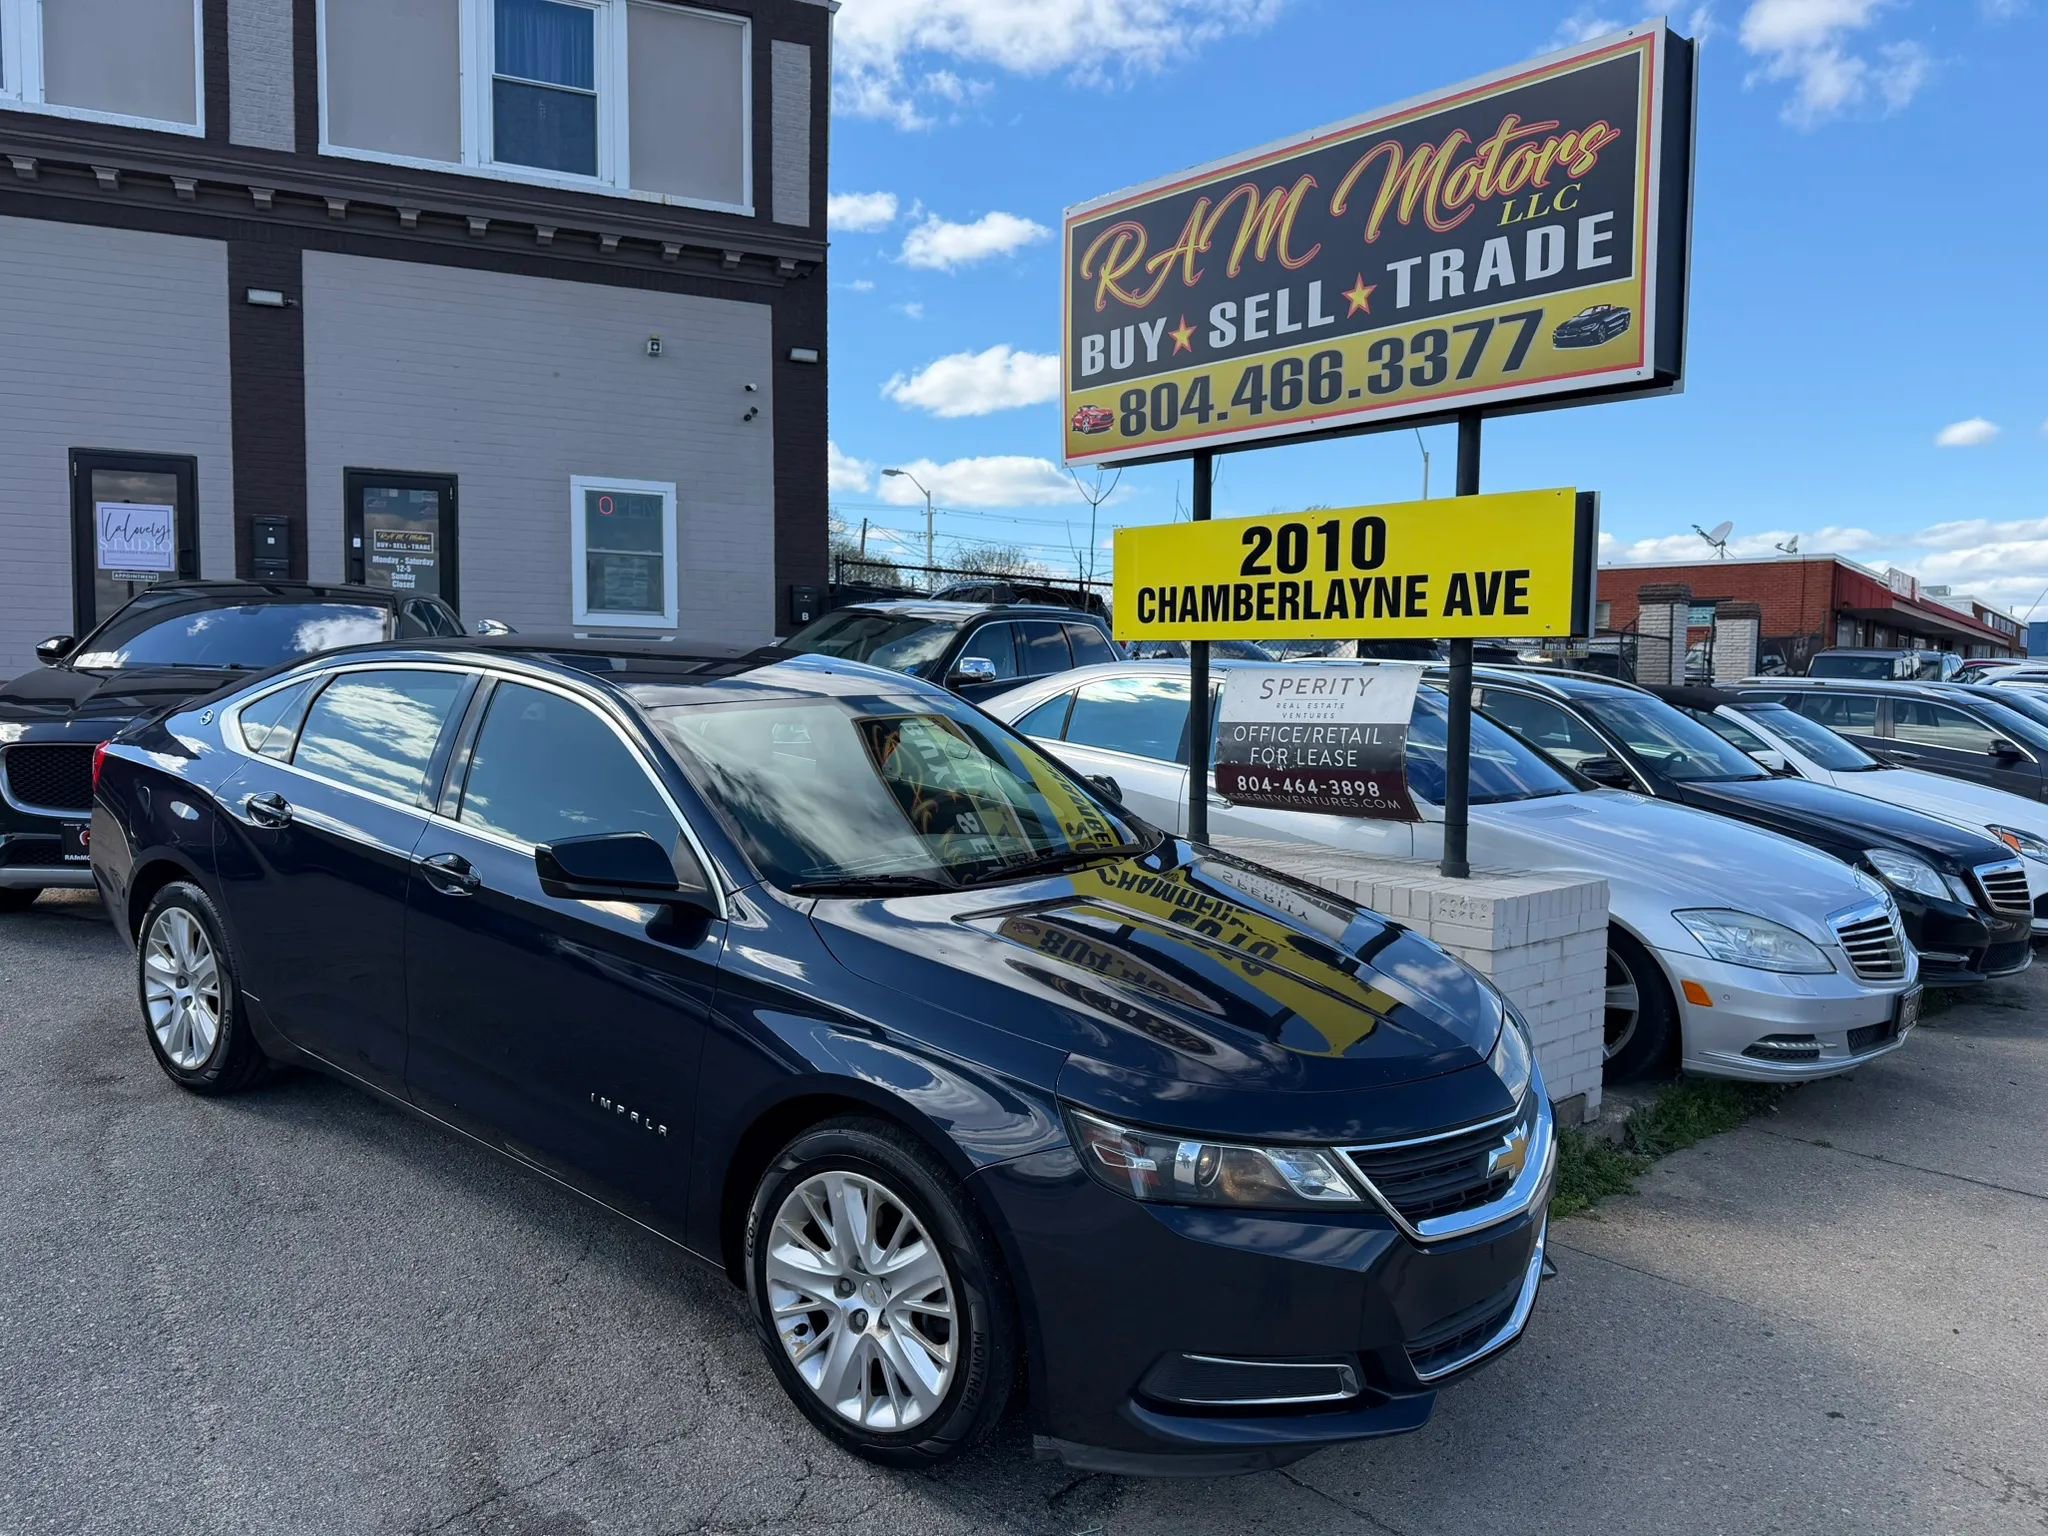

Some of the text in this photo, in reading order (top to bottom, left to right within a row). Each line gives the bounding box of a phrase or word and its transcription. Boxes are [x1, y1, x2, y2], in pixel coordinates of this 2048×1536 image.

[1080, 113, 1621, 312] RAM Motors
[1497, 182, 1583, 227] LLC
[1081, 211, 1614, 377] BUY SELL TRADE
[1118, 308, 1545, 438] 804.466.3377
[1240, 516, 1386, 577] 2010
[372, 555, 399, 565] Monday
[405, 557, 434, 567] Saturday
[391, 572, 416, 581] Sunday
[392, 580, 415, 588] Closed
[1136, 568, 1530, 624] CHAMBERLAYNE AVE
[801, 611, 809, 621] B
[1259, 677, 1375, 700] SPERITY
[1307, 702, 1345, 710] ESTATE
[1233, 725, 1383, 745] OFFICE/RETAIL
[1250, 747, 1358, 767] FOR LEASE
[1237, 775, 1380, 798] 804-464-3898
[591, 1092, 667, 1137] IMPALA
